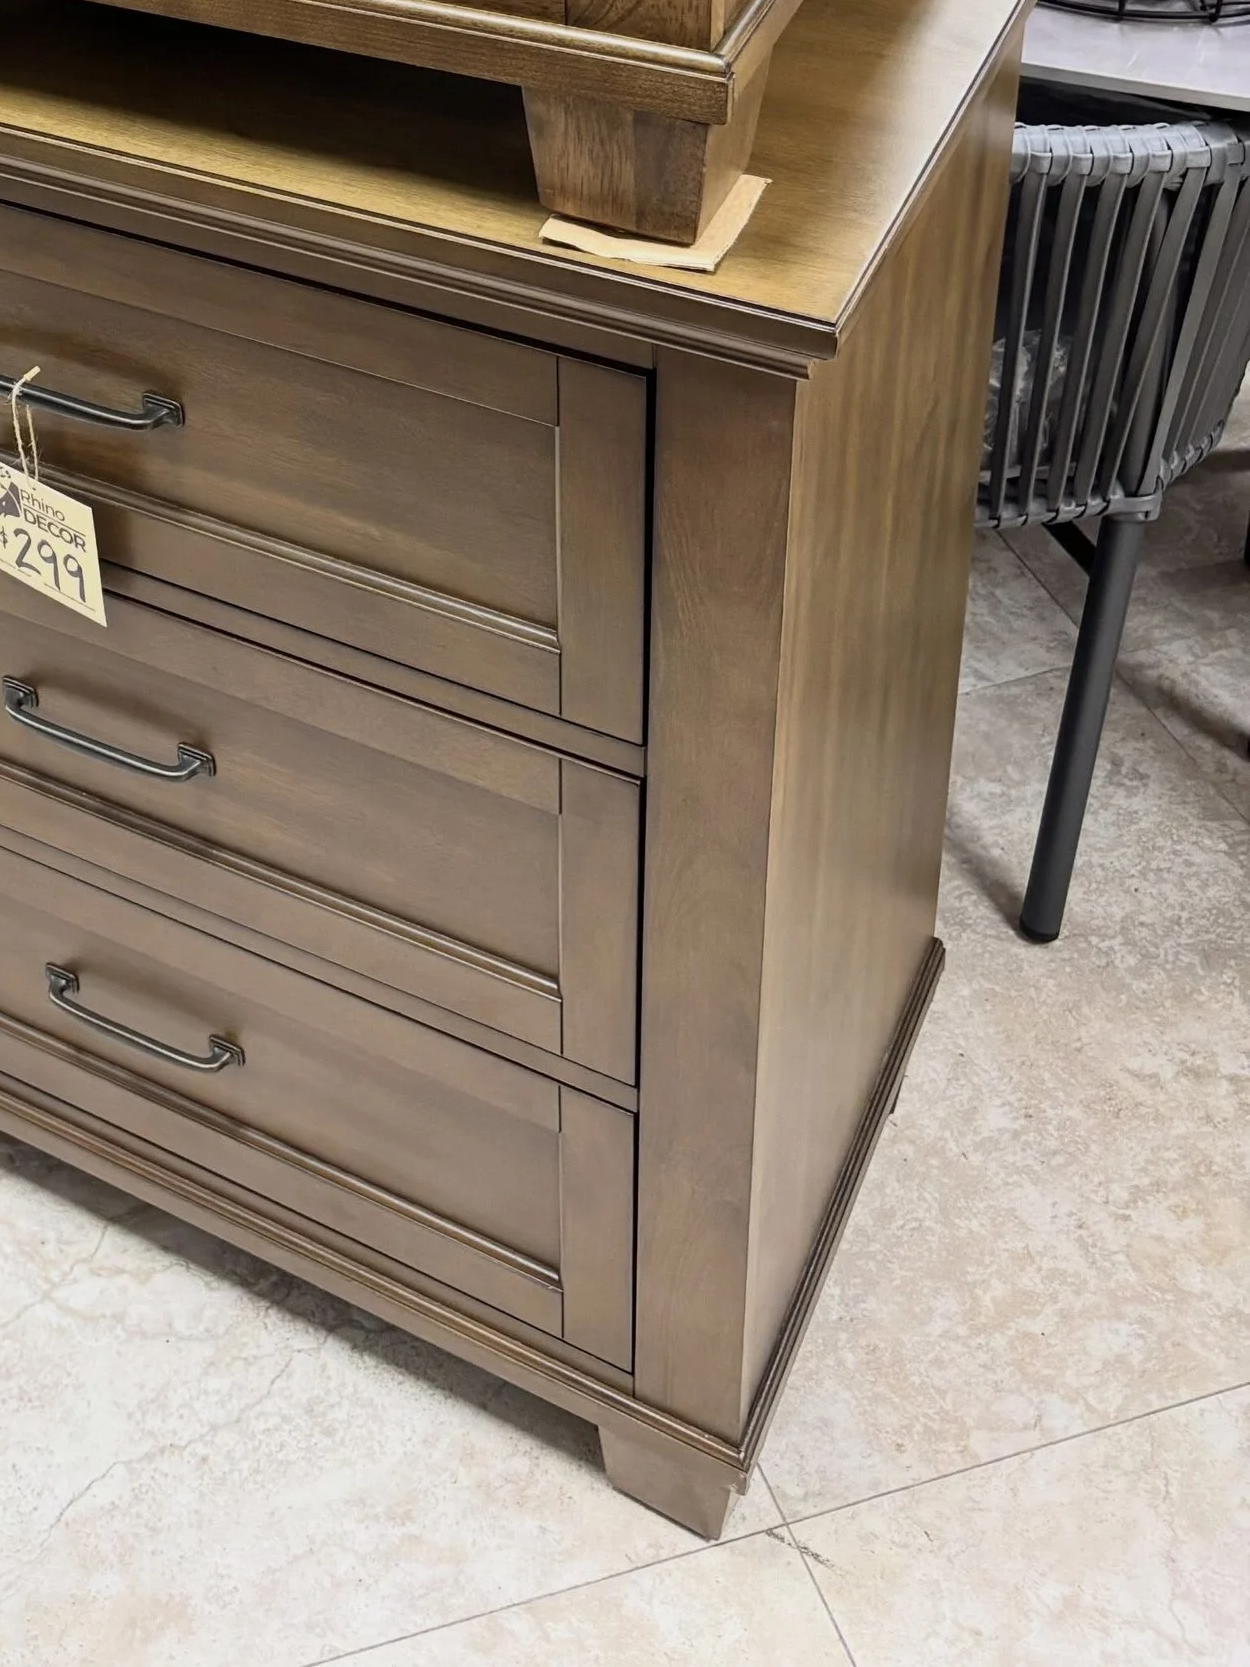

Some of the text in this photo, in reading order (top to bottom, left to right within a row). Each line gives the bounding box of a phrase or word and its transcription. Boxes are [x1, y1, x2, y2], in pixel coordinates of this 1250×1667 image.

[21, 489, 66, 522] Rhino
[24, 508, 86, 553] DECOR
[0, 526, 87, 604] $299
